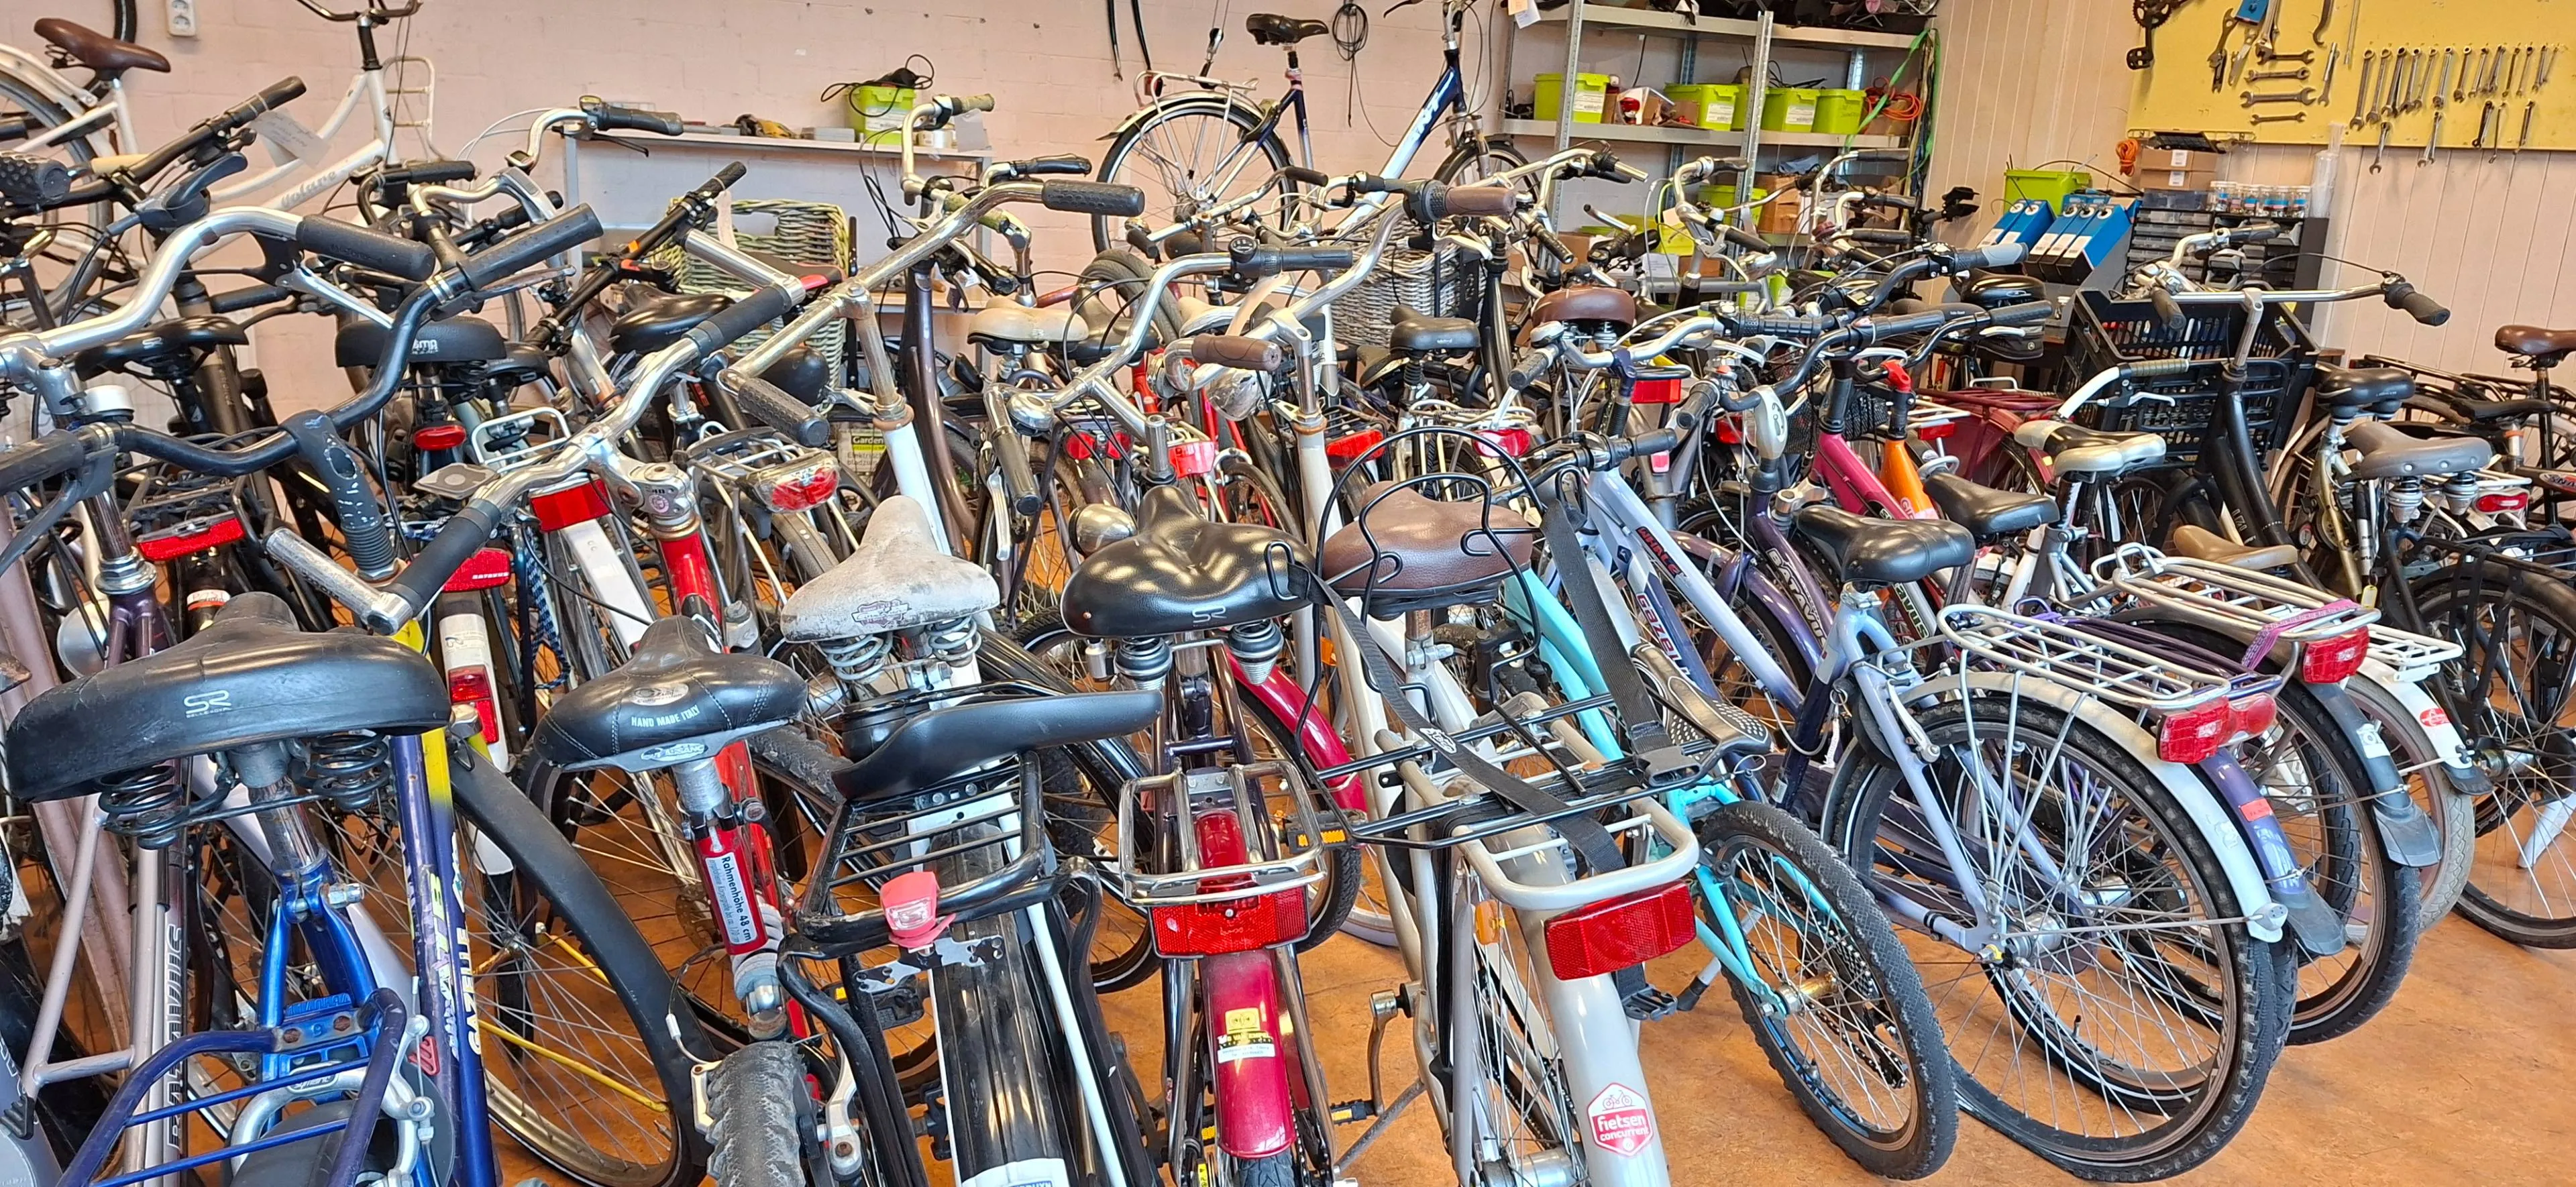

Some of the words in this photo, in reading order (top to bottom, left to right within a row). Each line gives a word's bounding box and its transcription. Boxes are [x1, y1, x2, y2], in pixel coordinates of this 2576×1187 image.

[282, 170, 337, 208] Volare
[853, 436, 884, 444] Garden
[472, 571, 509, 579] BATAVUS
[1894, 582, 1929, 637] avus
[1637, 594, 1690, 676] Gazell
[183, 689, 232, 714] SR
[631, 716, 655, 728] HAND
[656, 714, 681, 726] MADE
[681, 704, 700, 720] ITALY
[721, 856, 744, 913] Rahmenhöhe
[739, 914, 750, 927] 48
[743, 927, 752, 941] cm
[456, 927, 482, 1055] GAZELLE
[1597, 1114, 1647, 1133] fietsen
[1599, 1127, 1650, 1142] concurrent
